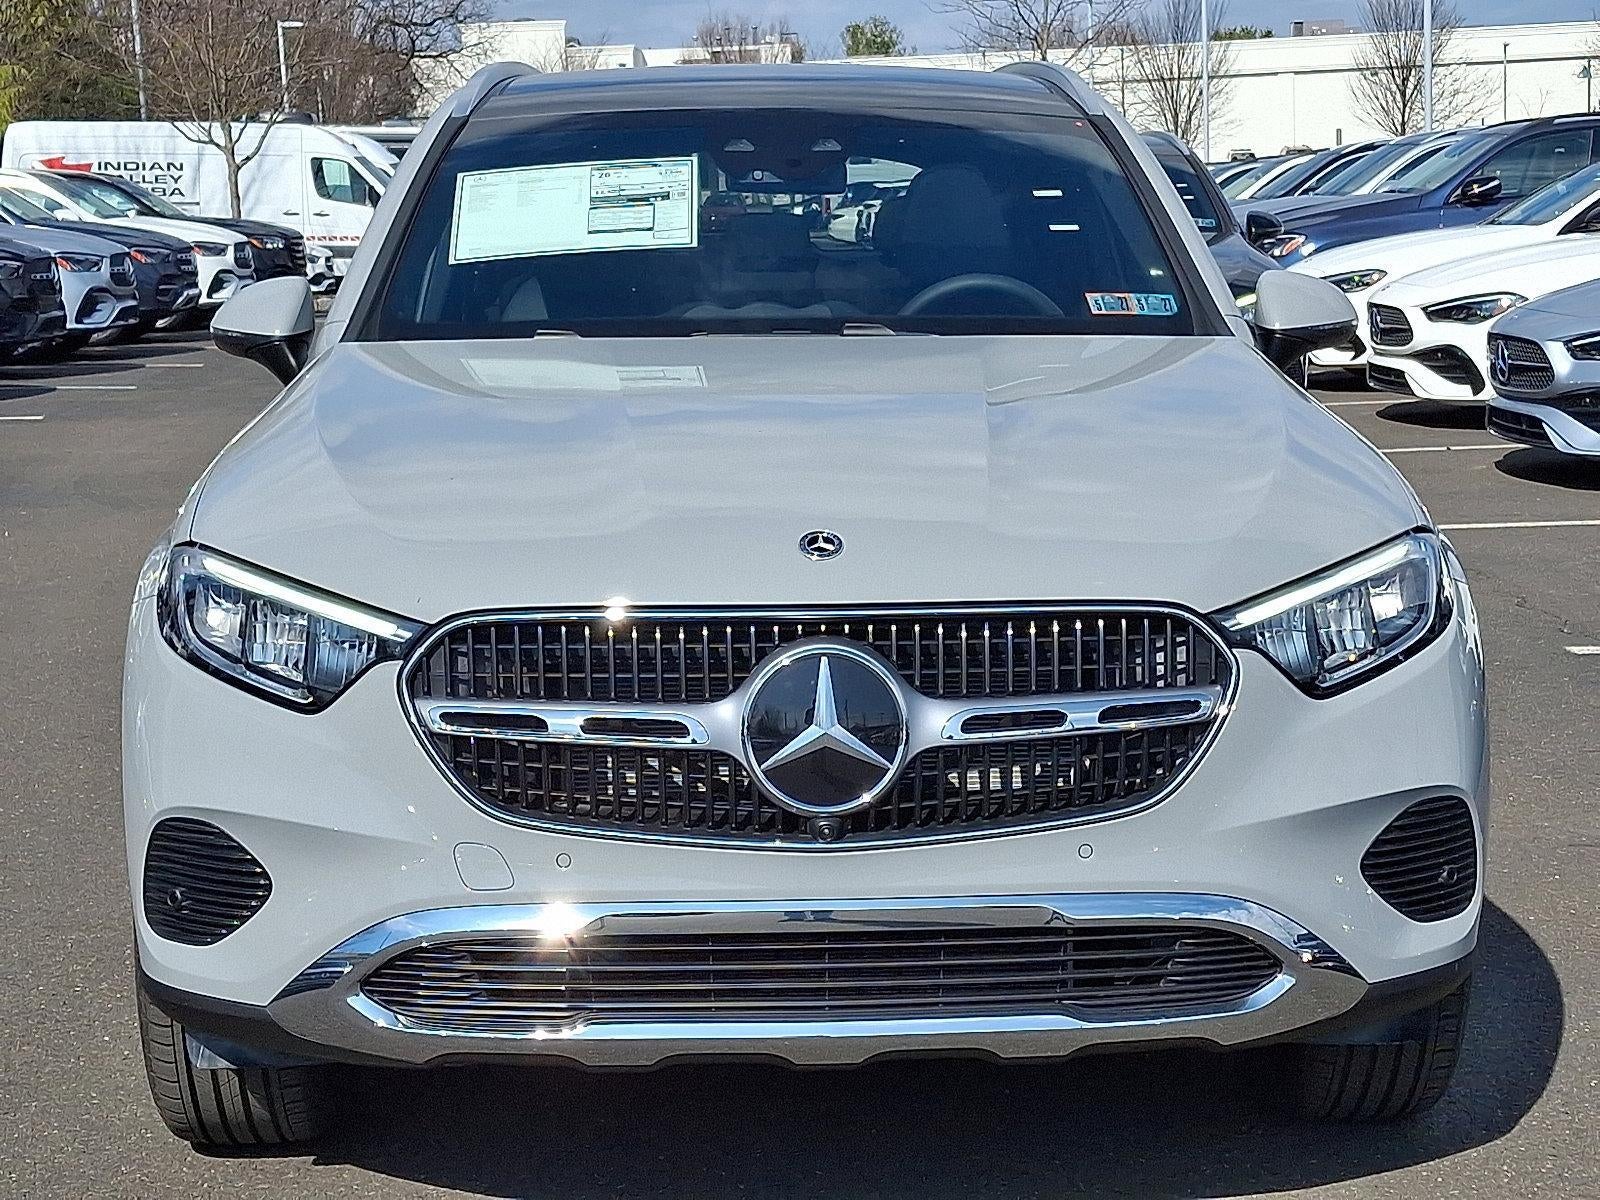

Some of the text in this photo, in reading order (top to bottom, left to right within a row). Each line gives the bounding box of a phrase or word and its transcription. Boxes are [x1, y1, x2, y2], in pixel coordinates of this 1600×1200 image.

[98, 161, 184, 171] INDIAN
[129, 174, 183, 184] LLEY
[146, 187, 185, 197] SA
